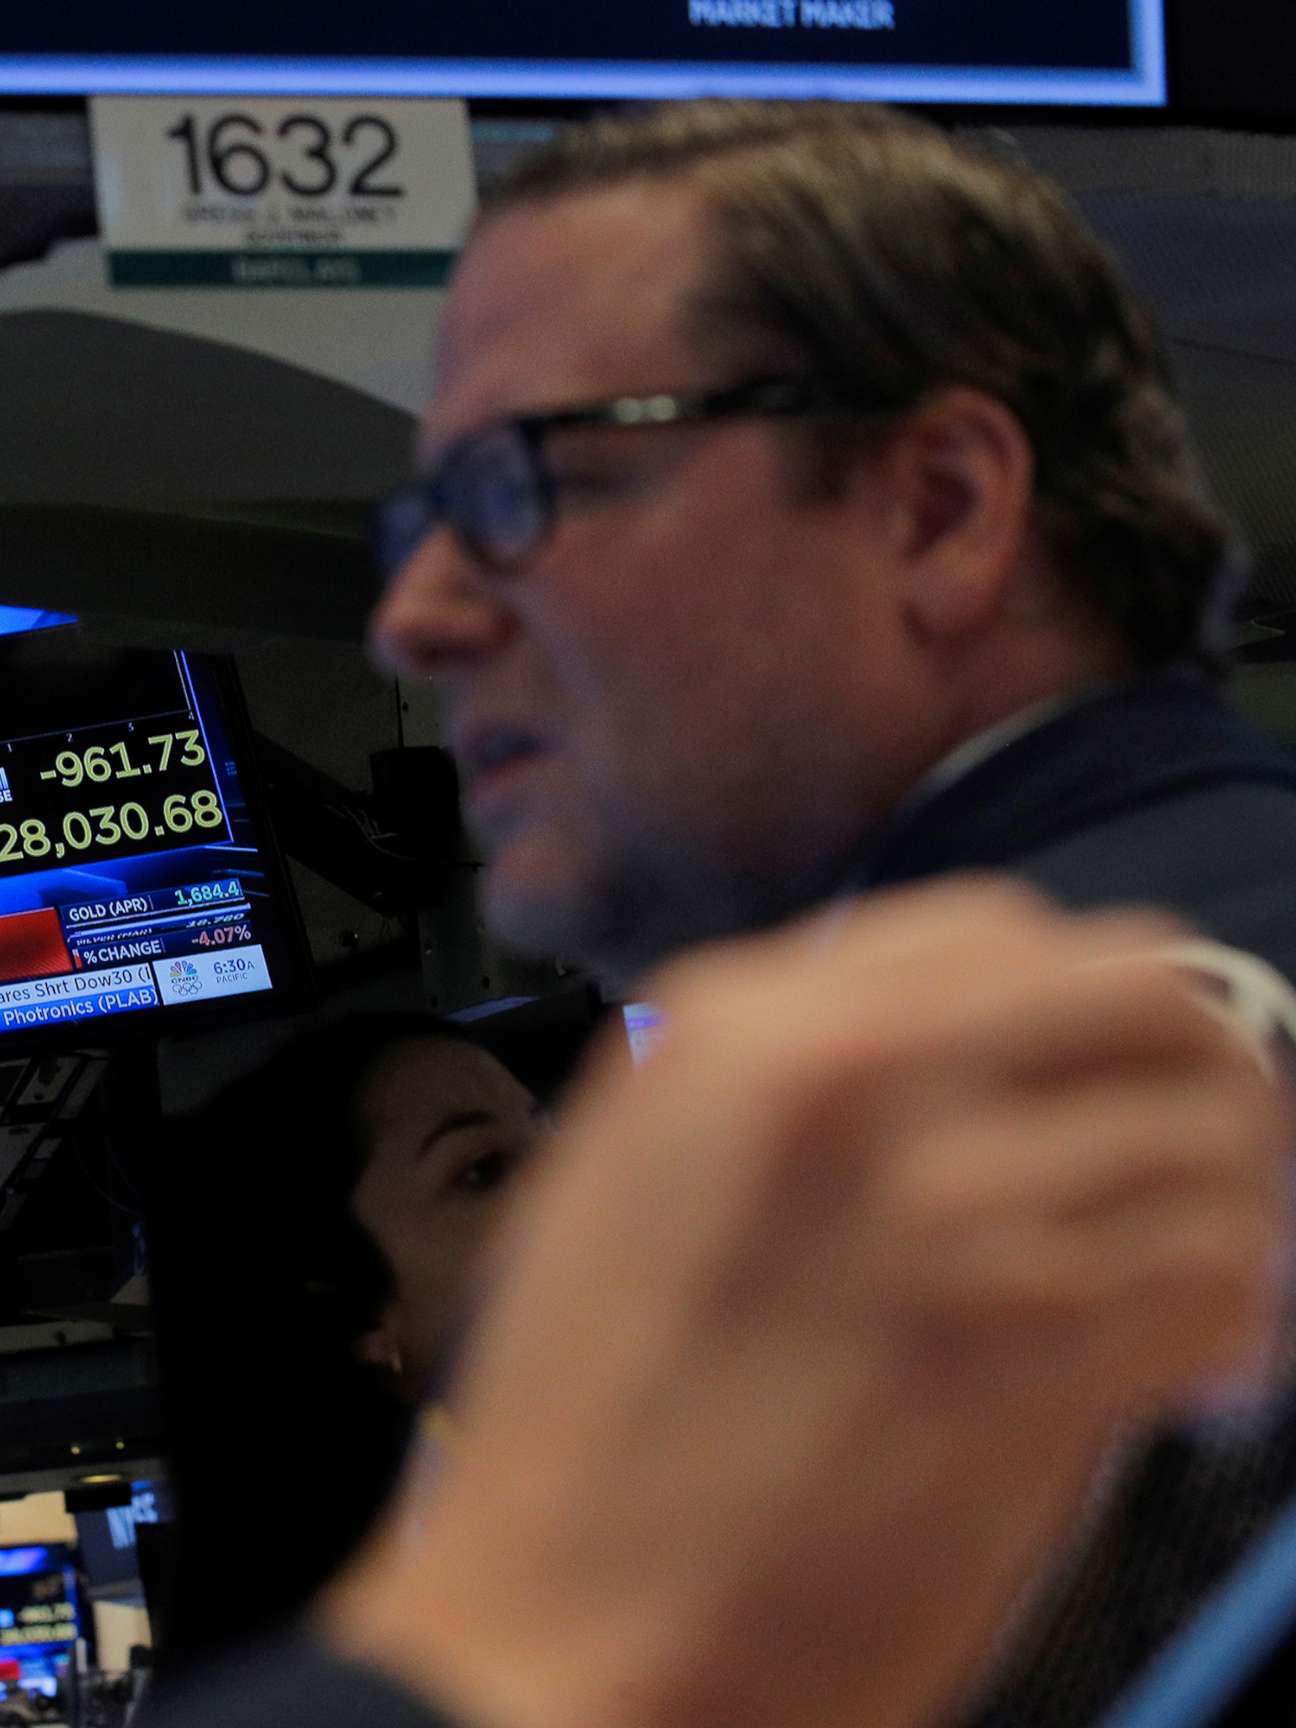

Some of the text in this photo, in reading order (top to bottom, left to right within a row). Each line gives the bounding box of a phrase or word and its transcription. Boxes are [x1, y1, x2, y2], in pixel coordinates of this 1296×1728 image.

[688, 0, 895, 29] MARKET MAKER
[167, 112, 403, 197] 1632
[40, 729, 205, 788] -961.73
[69, 880, 240, 922] GOLD (APR) 1,684.4
[84, 924, 252, 964] % CHANGE -4.07%
[34, 979, 70, 997] Shrt
[75, 969, 132, 992] Dow30
[216, 972, 248, 984] PACIFIC
[4, 1000, 94, 1026] Photronics
[98, 987, 159, 1012] (PLAB)
